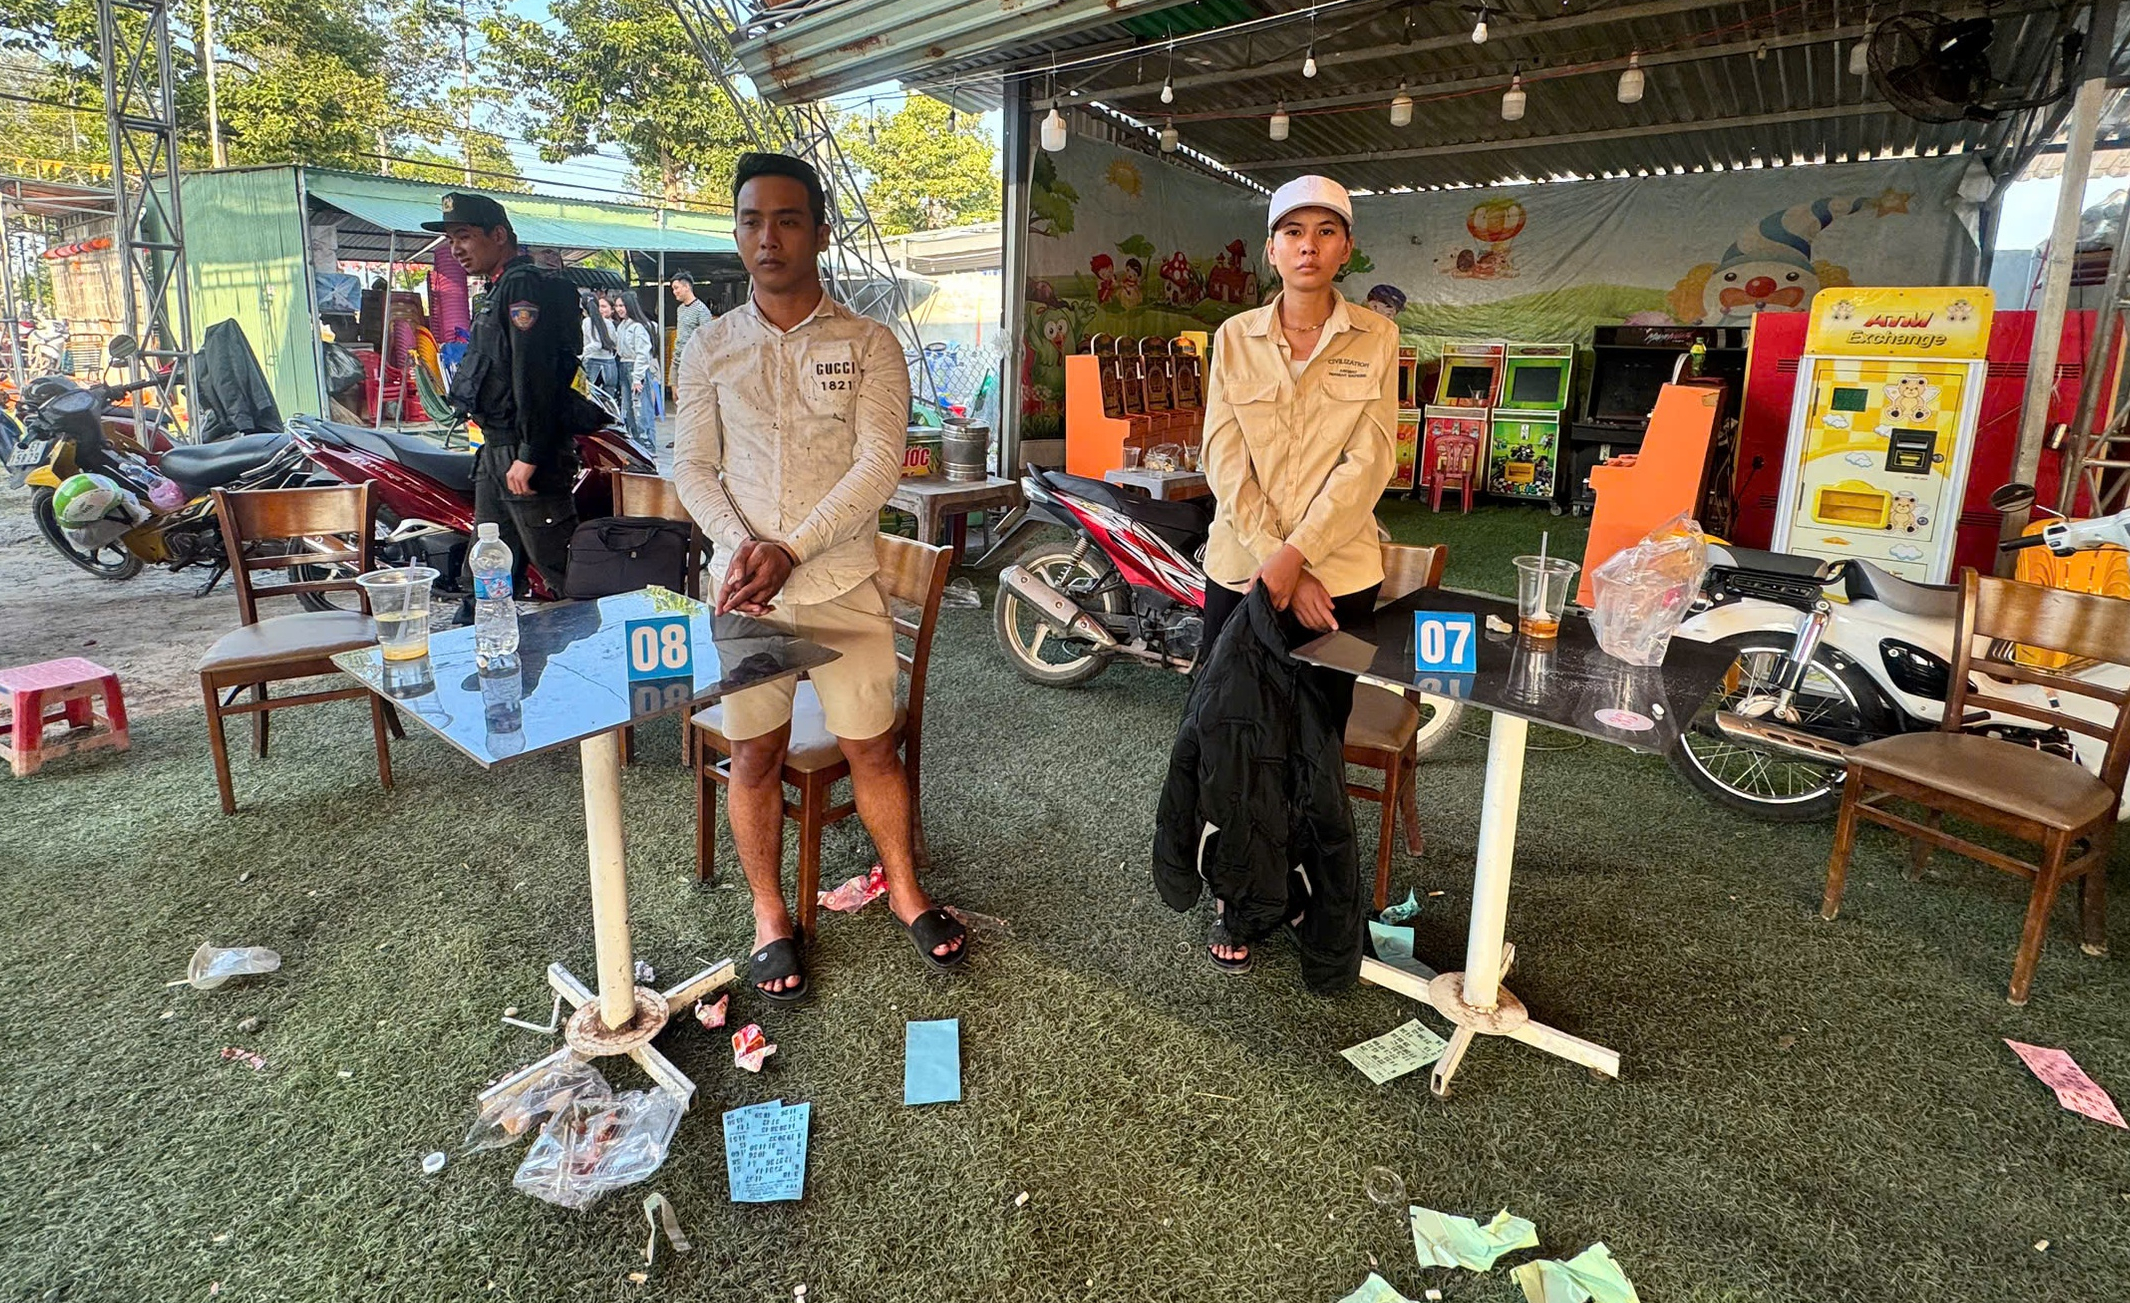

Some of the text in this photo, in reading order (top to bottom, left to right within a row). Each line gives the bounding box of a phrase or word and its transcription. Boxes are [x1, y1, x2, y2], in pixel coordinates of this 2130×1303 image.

[1864, 311, 1934, 328] ATM
[1847, 330, 1947, 348] Exchange
[816, 362, 855, 375] GUCCI
[821, 381, 852, 391] 1821
[631, 623, 688, 672] 08
[1420, 620, 1471, 664] 07
